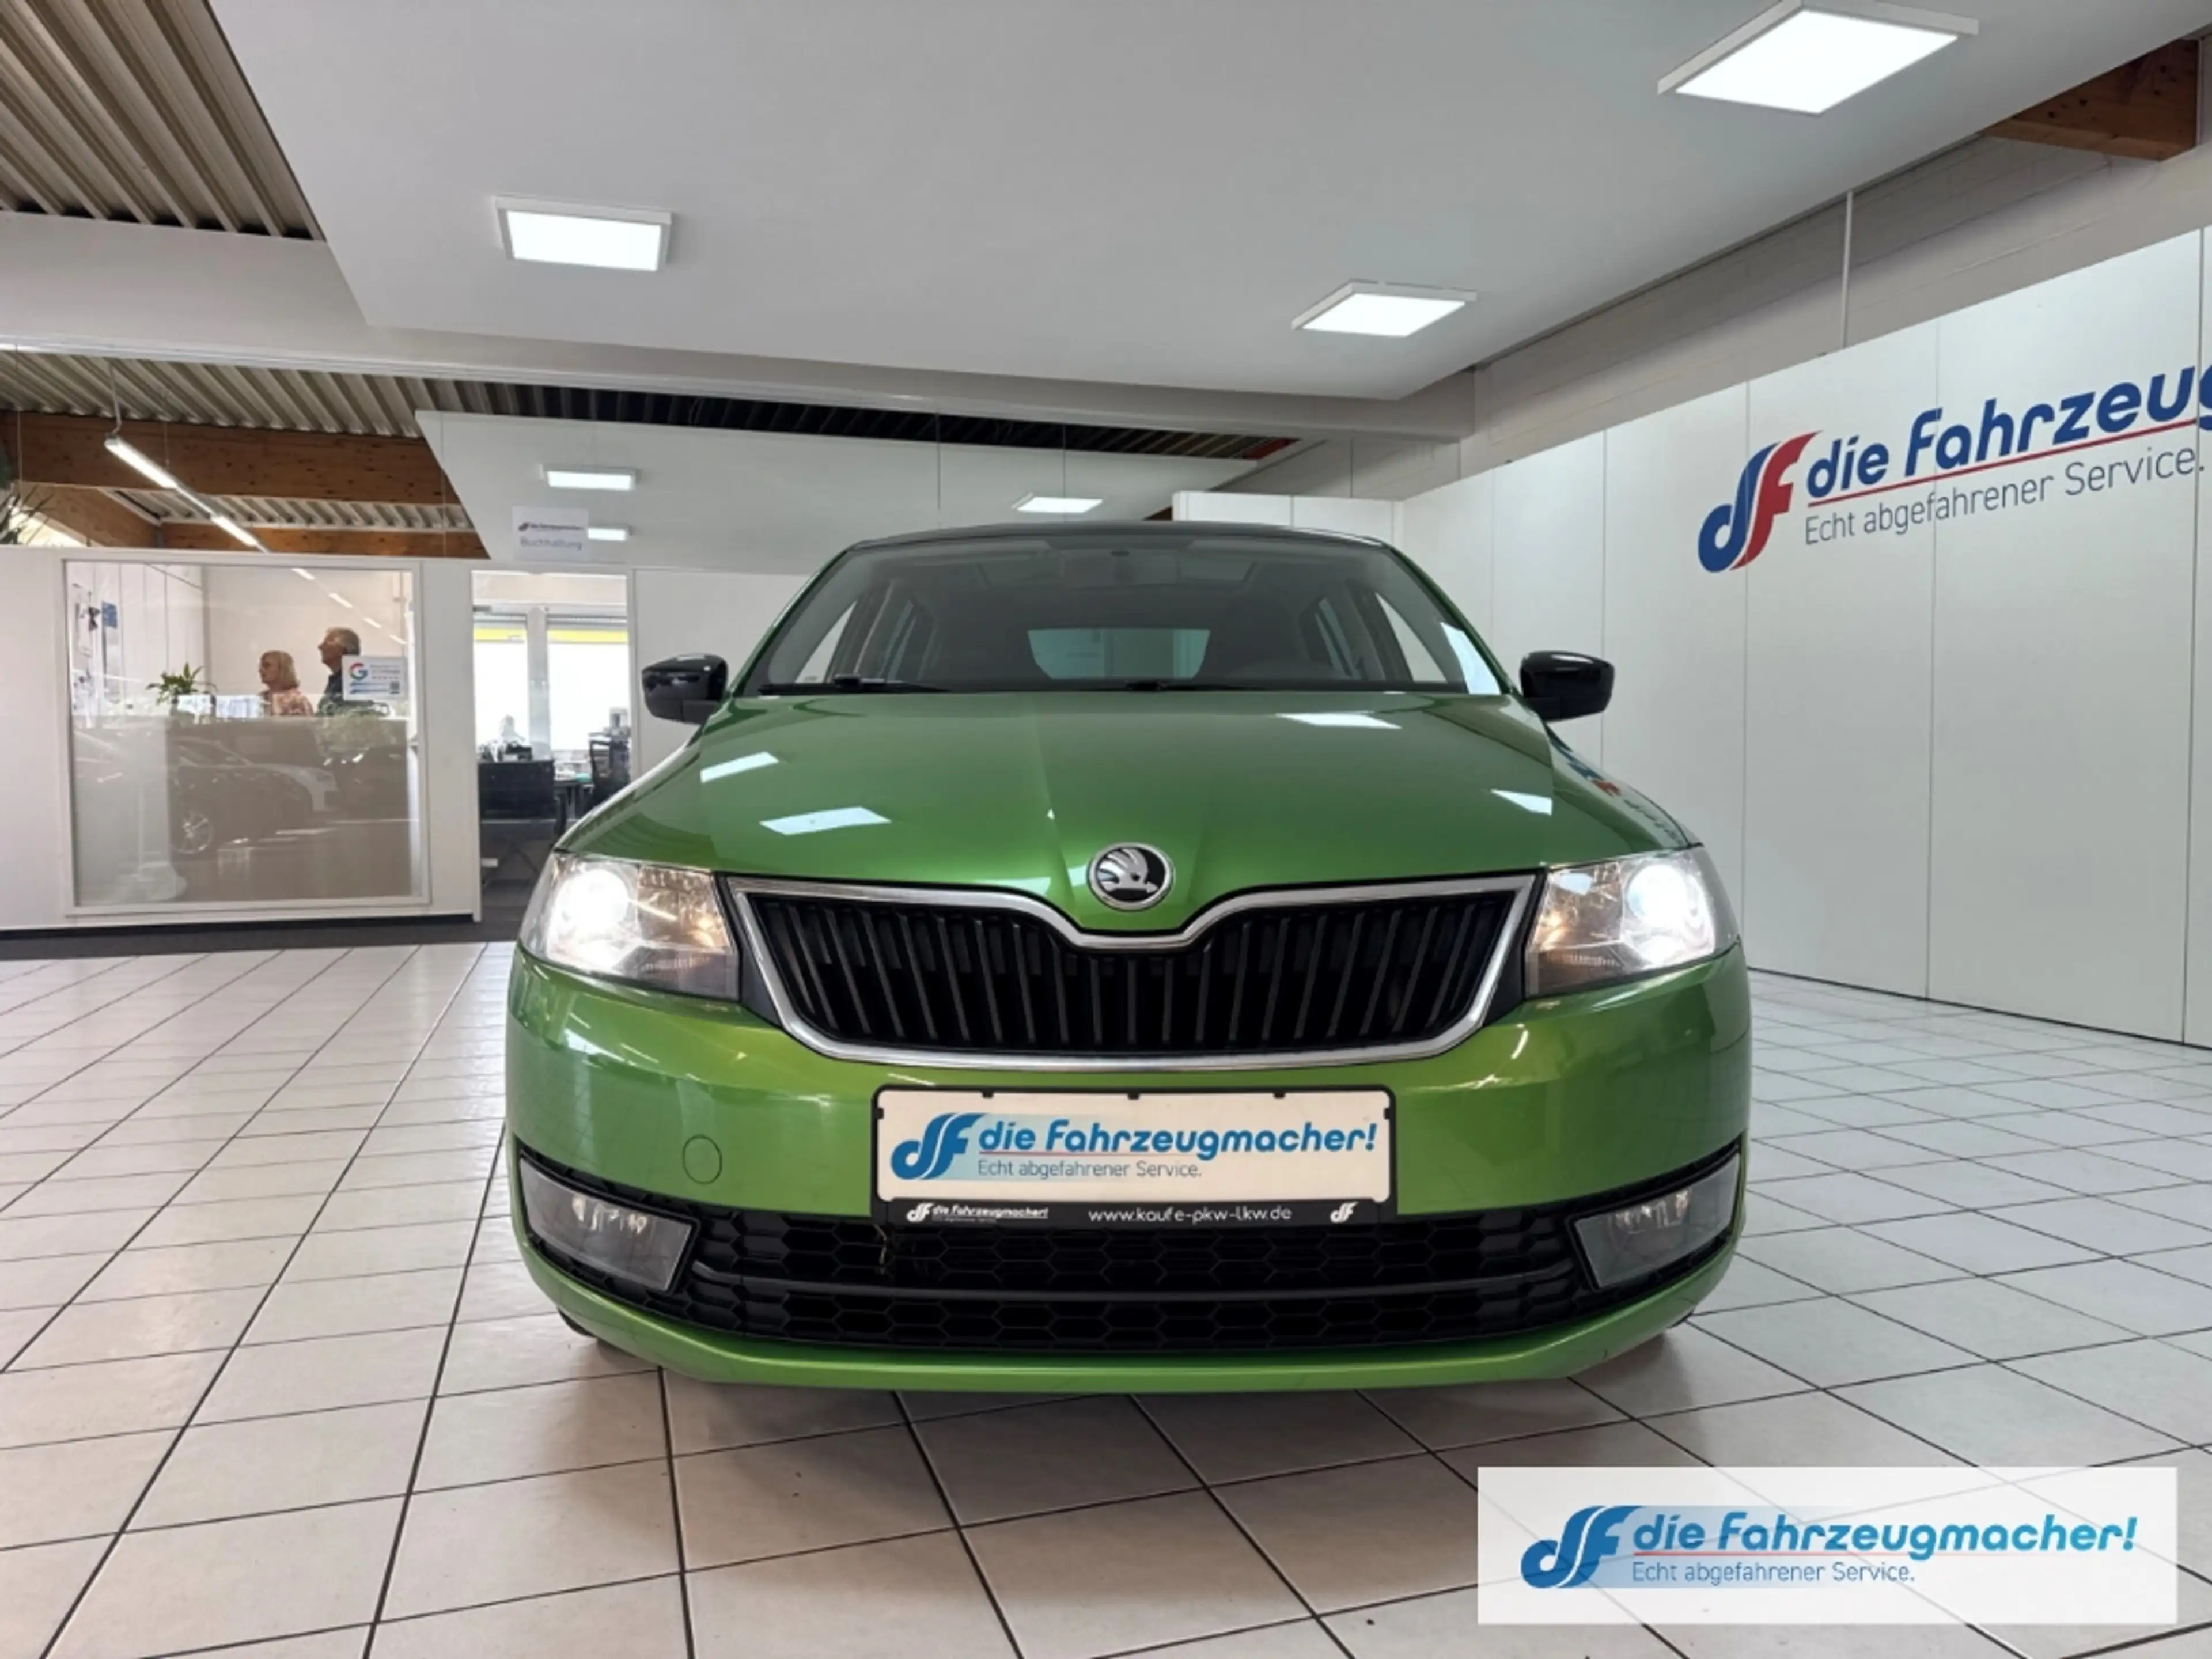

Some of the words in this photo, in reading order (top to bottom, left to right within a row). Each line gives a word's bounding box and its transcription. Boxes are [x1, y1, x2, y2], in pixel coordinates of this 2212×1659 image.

[1806, 434, 1889, 498] die
[1904, 365, 2212, 477] Fahrzeu
[1805, 512, 1855, 545] Echt
[1863, 474, 2054, 535] abgefahrener
[2065, 446, 2205, 496] Service.
[979, 1120, 1036, 1151] die
[1045, 1118, 1377, 1161] Fahrzeugmacher!
[978, 1159, 1014, 1176] Echt
[1018, 1159, 1130, 1180] abgefahrener
[1135, 1160, 1202, 1178] Service.
[1088, 1206, 1293, 1225] www.kaufe-pkw-lkw.de
